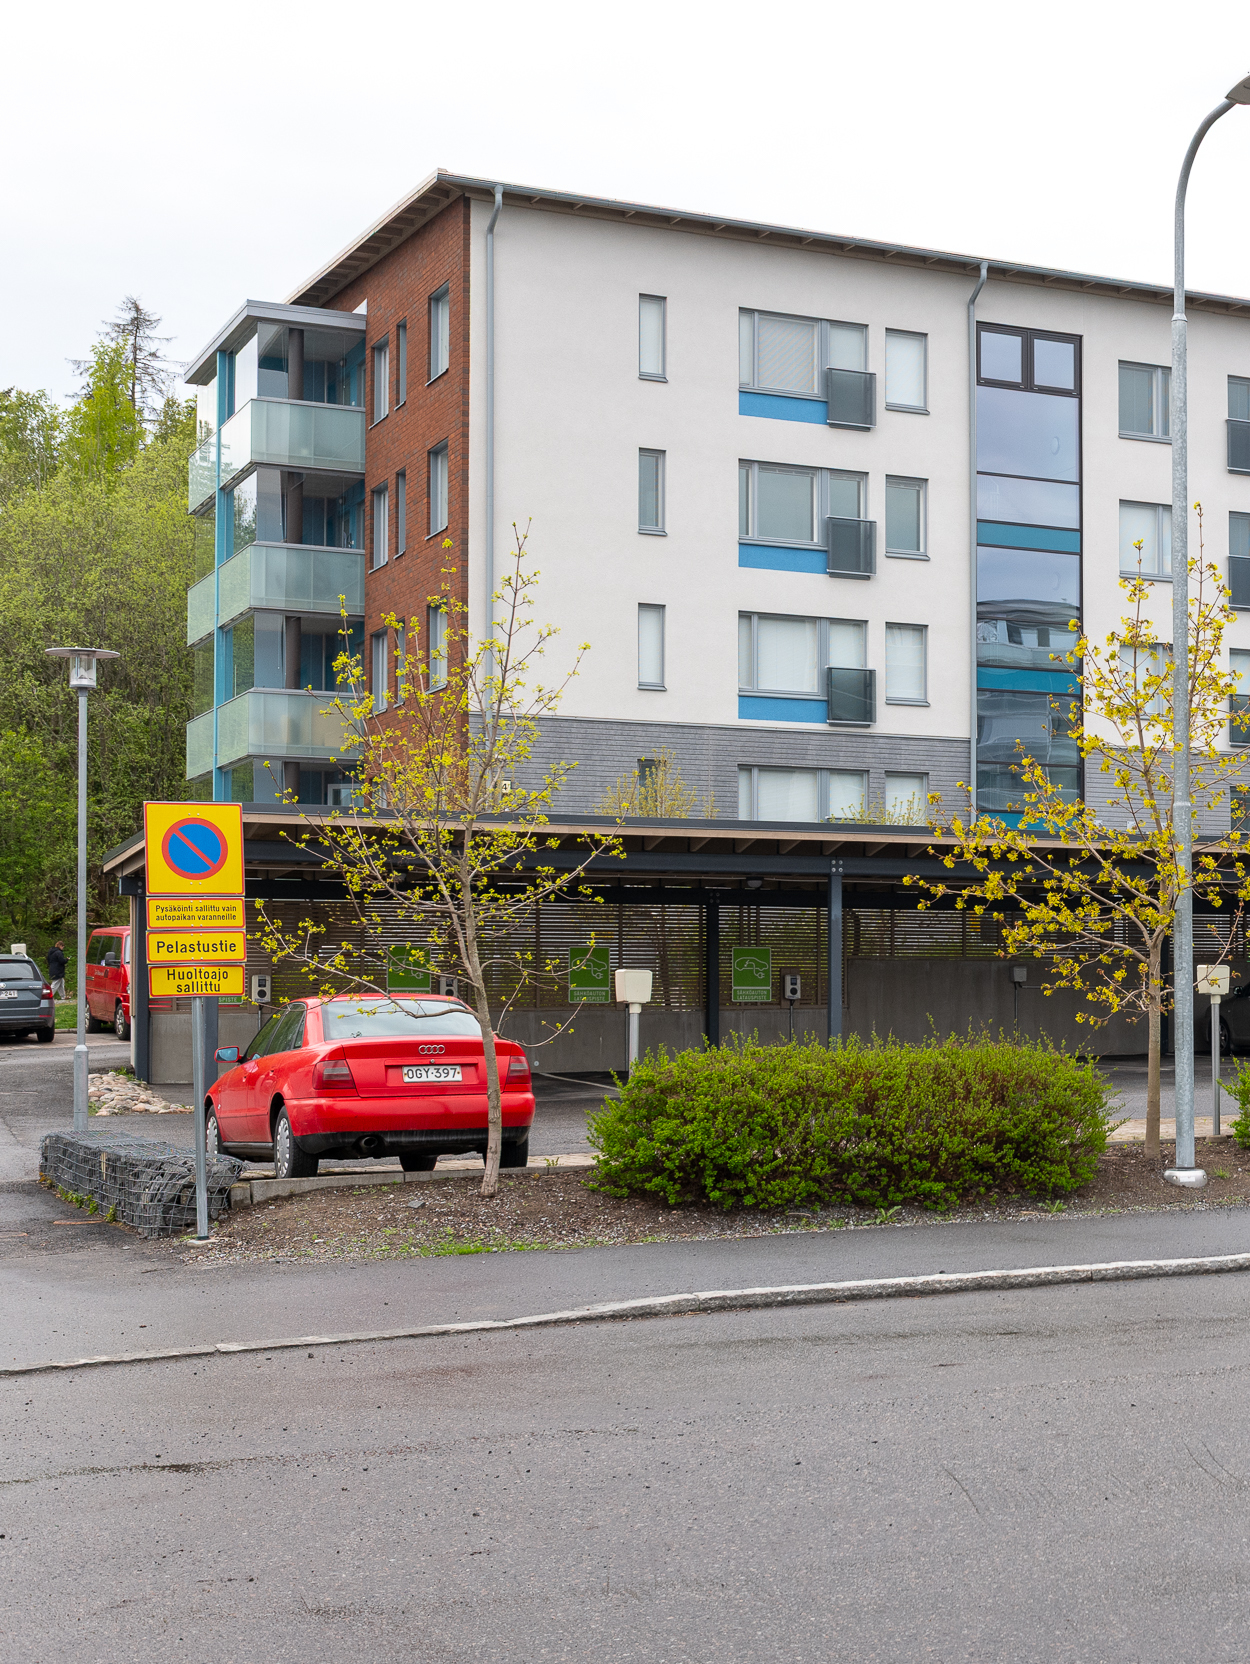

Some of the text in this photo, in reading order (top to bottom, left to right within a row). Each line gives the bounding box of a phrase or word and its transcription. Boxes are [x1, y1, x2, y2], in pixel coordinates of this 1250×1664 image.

[155, 904, 237, 913] Pysäköinti sallittu vain
[155, 913, 237, 922] autopaikan varanneille
[156, 939, 237, 954] Pelastustie
[167, 967, 229, 982] Huoltoajo
[176, 980, 221, 993] sallittu
[406, 1067, 458, 1080] OGY-397
